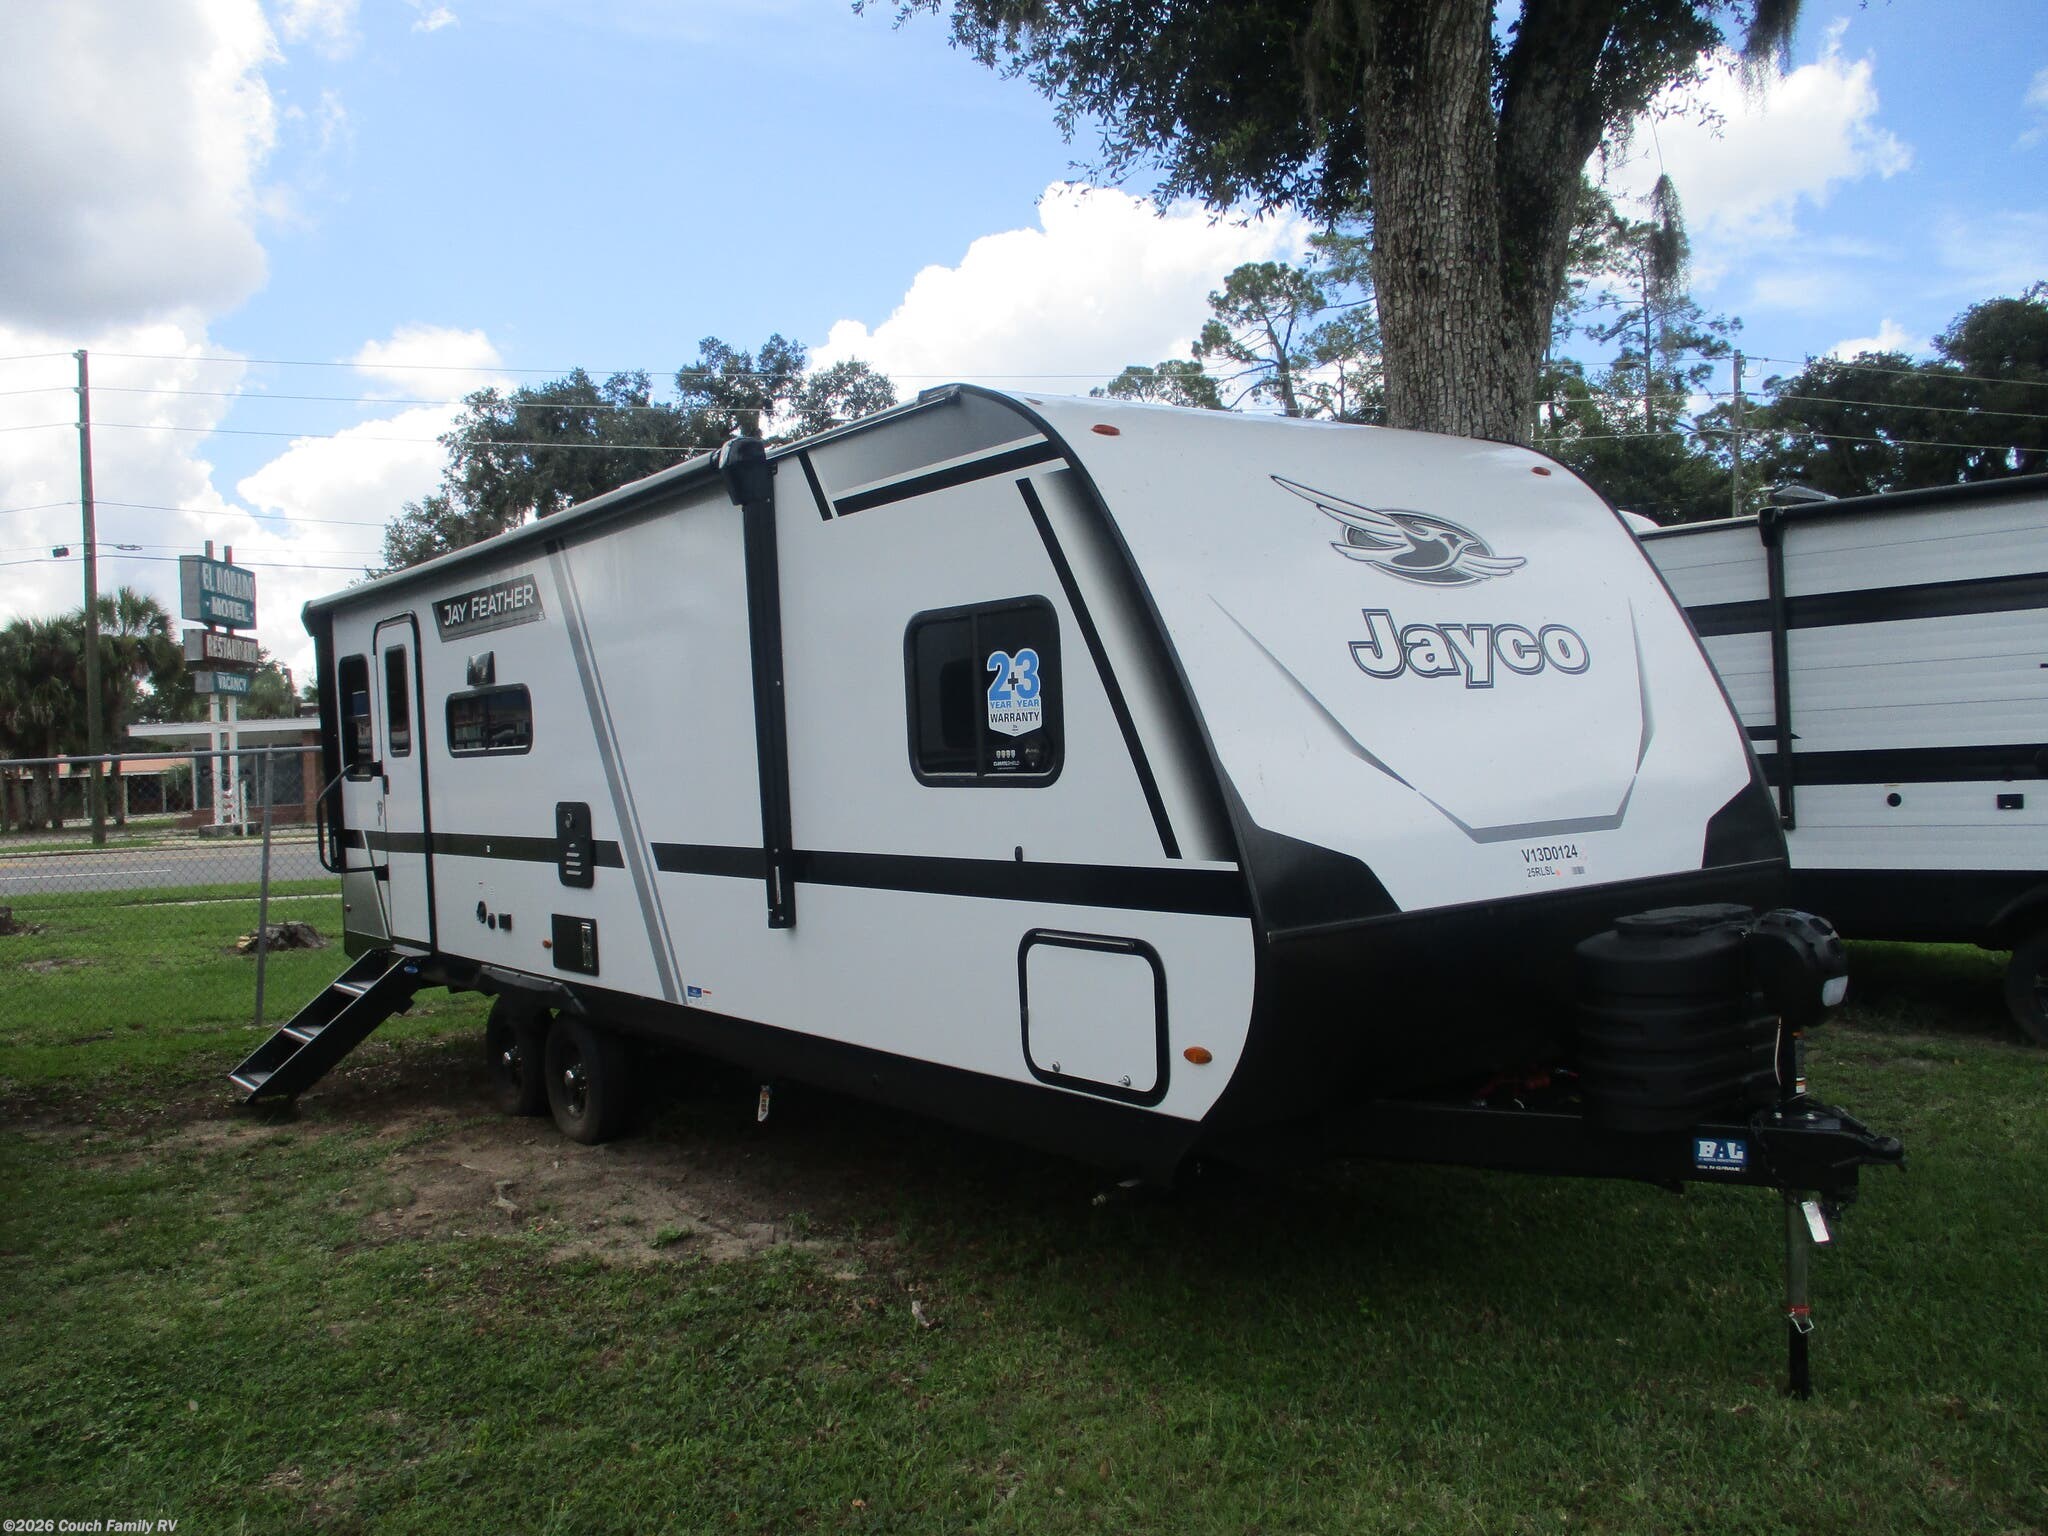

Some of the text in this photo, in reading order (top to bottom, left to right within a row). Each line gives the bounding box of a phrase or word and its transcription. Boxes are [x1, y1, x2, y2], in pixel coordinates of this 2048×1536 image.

[202, 563, 215, 592] EL
[211, 596, 250, 623] MOTEL
[444, 583, 534, 626] JAY FEATHER
[1347, 608, 1591, 690] Jayco
[217, 675, 247, 693] VACANCY
[990, 699, 1040, 709] YEAR YEAR
[990, 711, 1040, 723] WARRANTY
[1521, 844, 1578, 863] V13D0124
